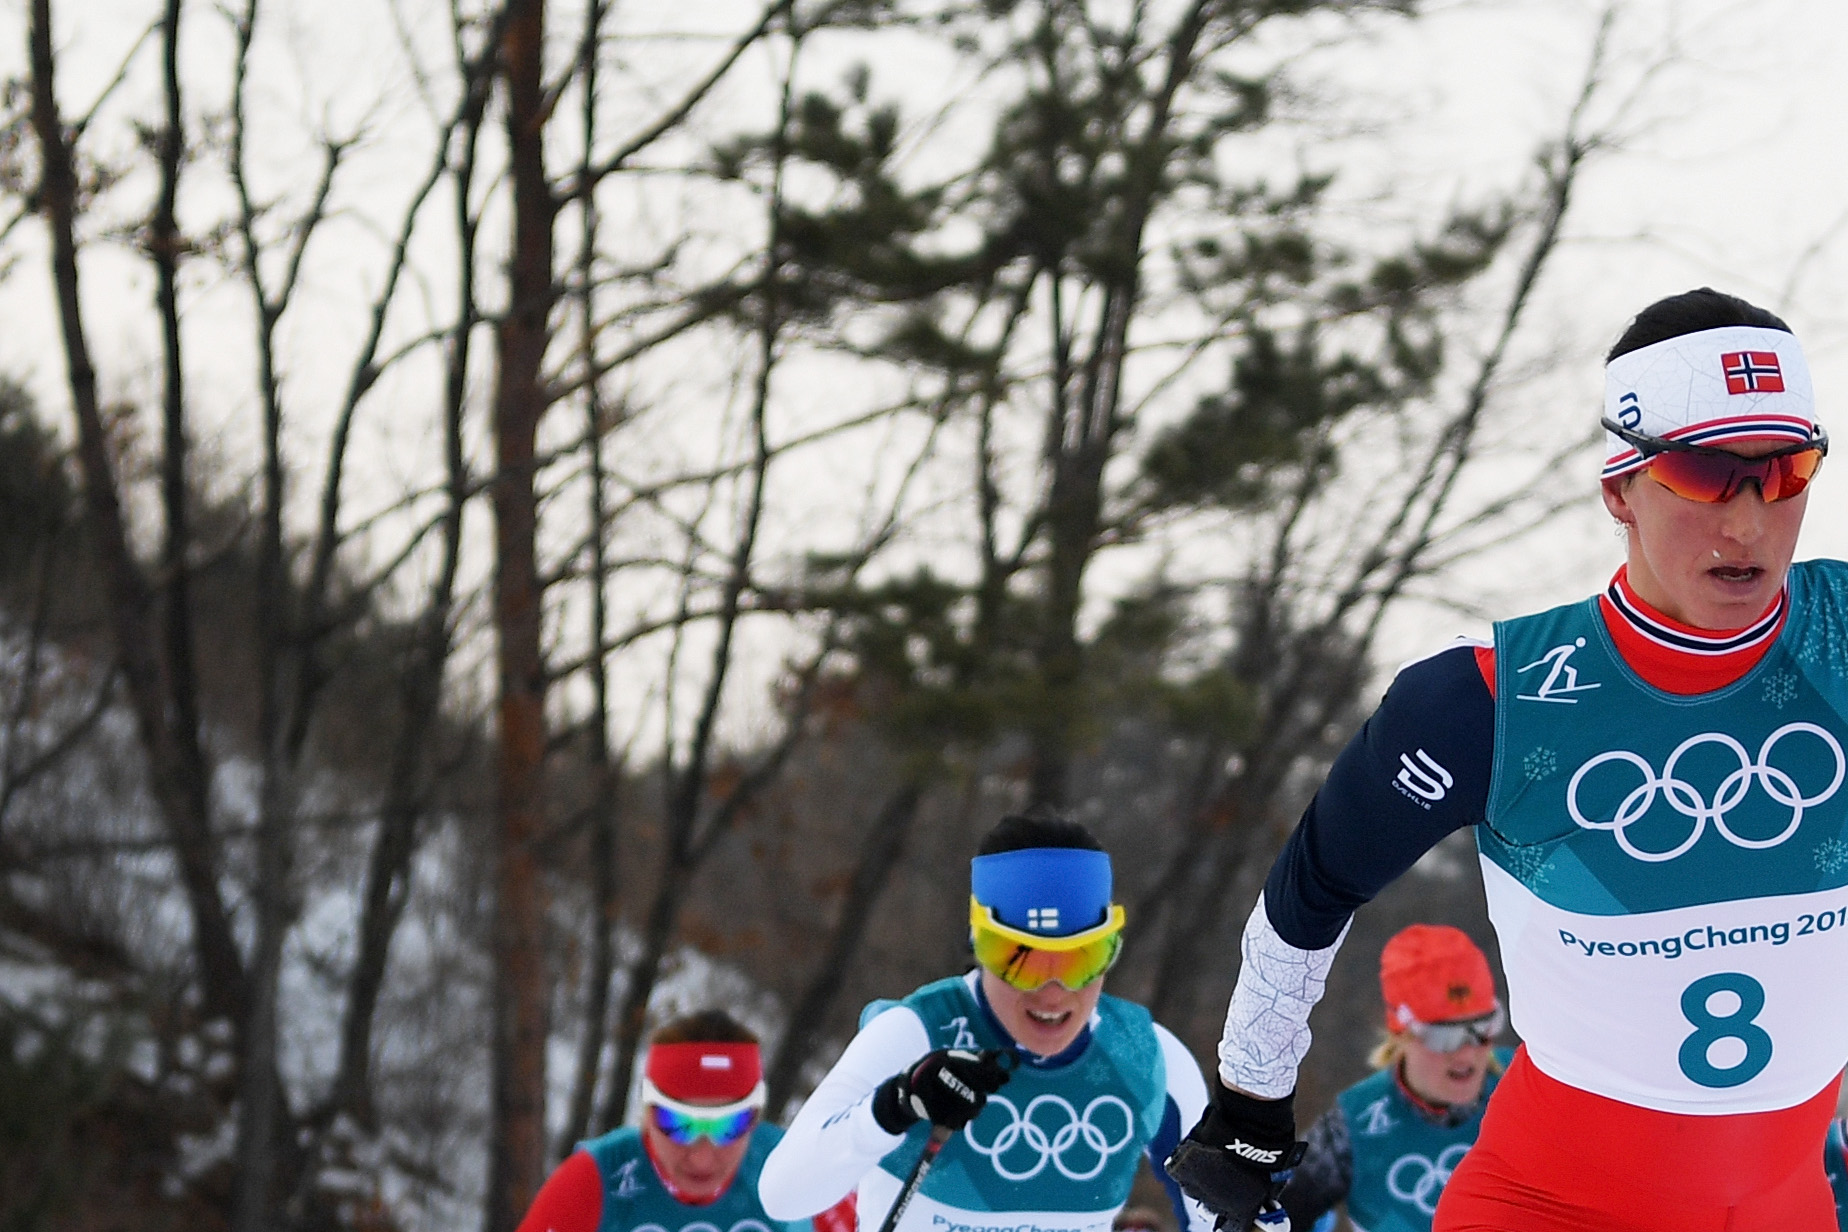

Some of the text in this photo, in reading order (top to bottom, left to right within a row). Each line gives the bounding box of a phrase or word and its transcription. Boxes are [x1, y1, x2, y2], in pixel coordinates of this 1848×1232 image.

[1558, 921, 1791, 959] PyeongChang
[1677, 971, 1774, 1089] 8
[1225, 1138, 1283, 1164] SWIX
